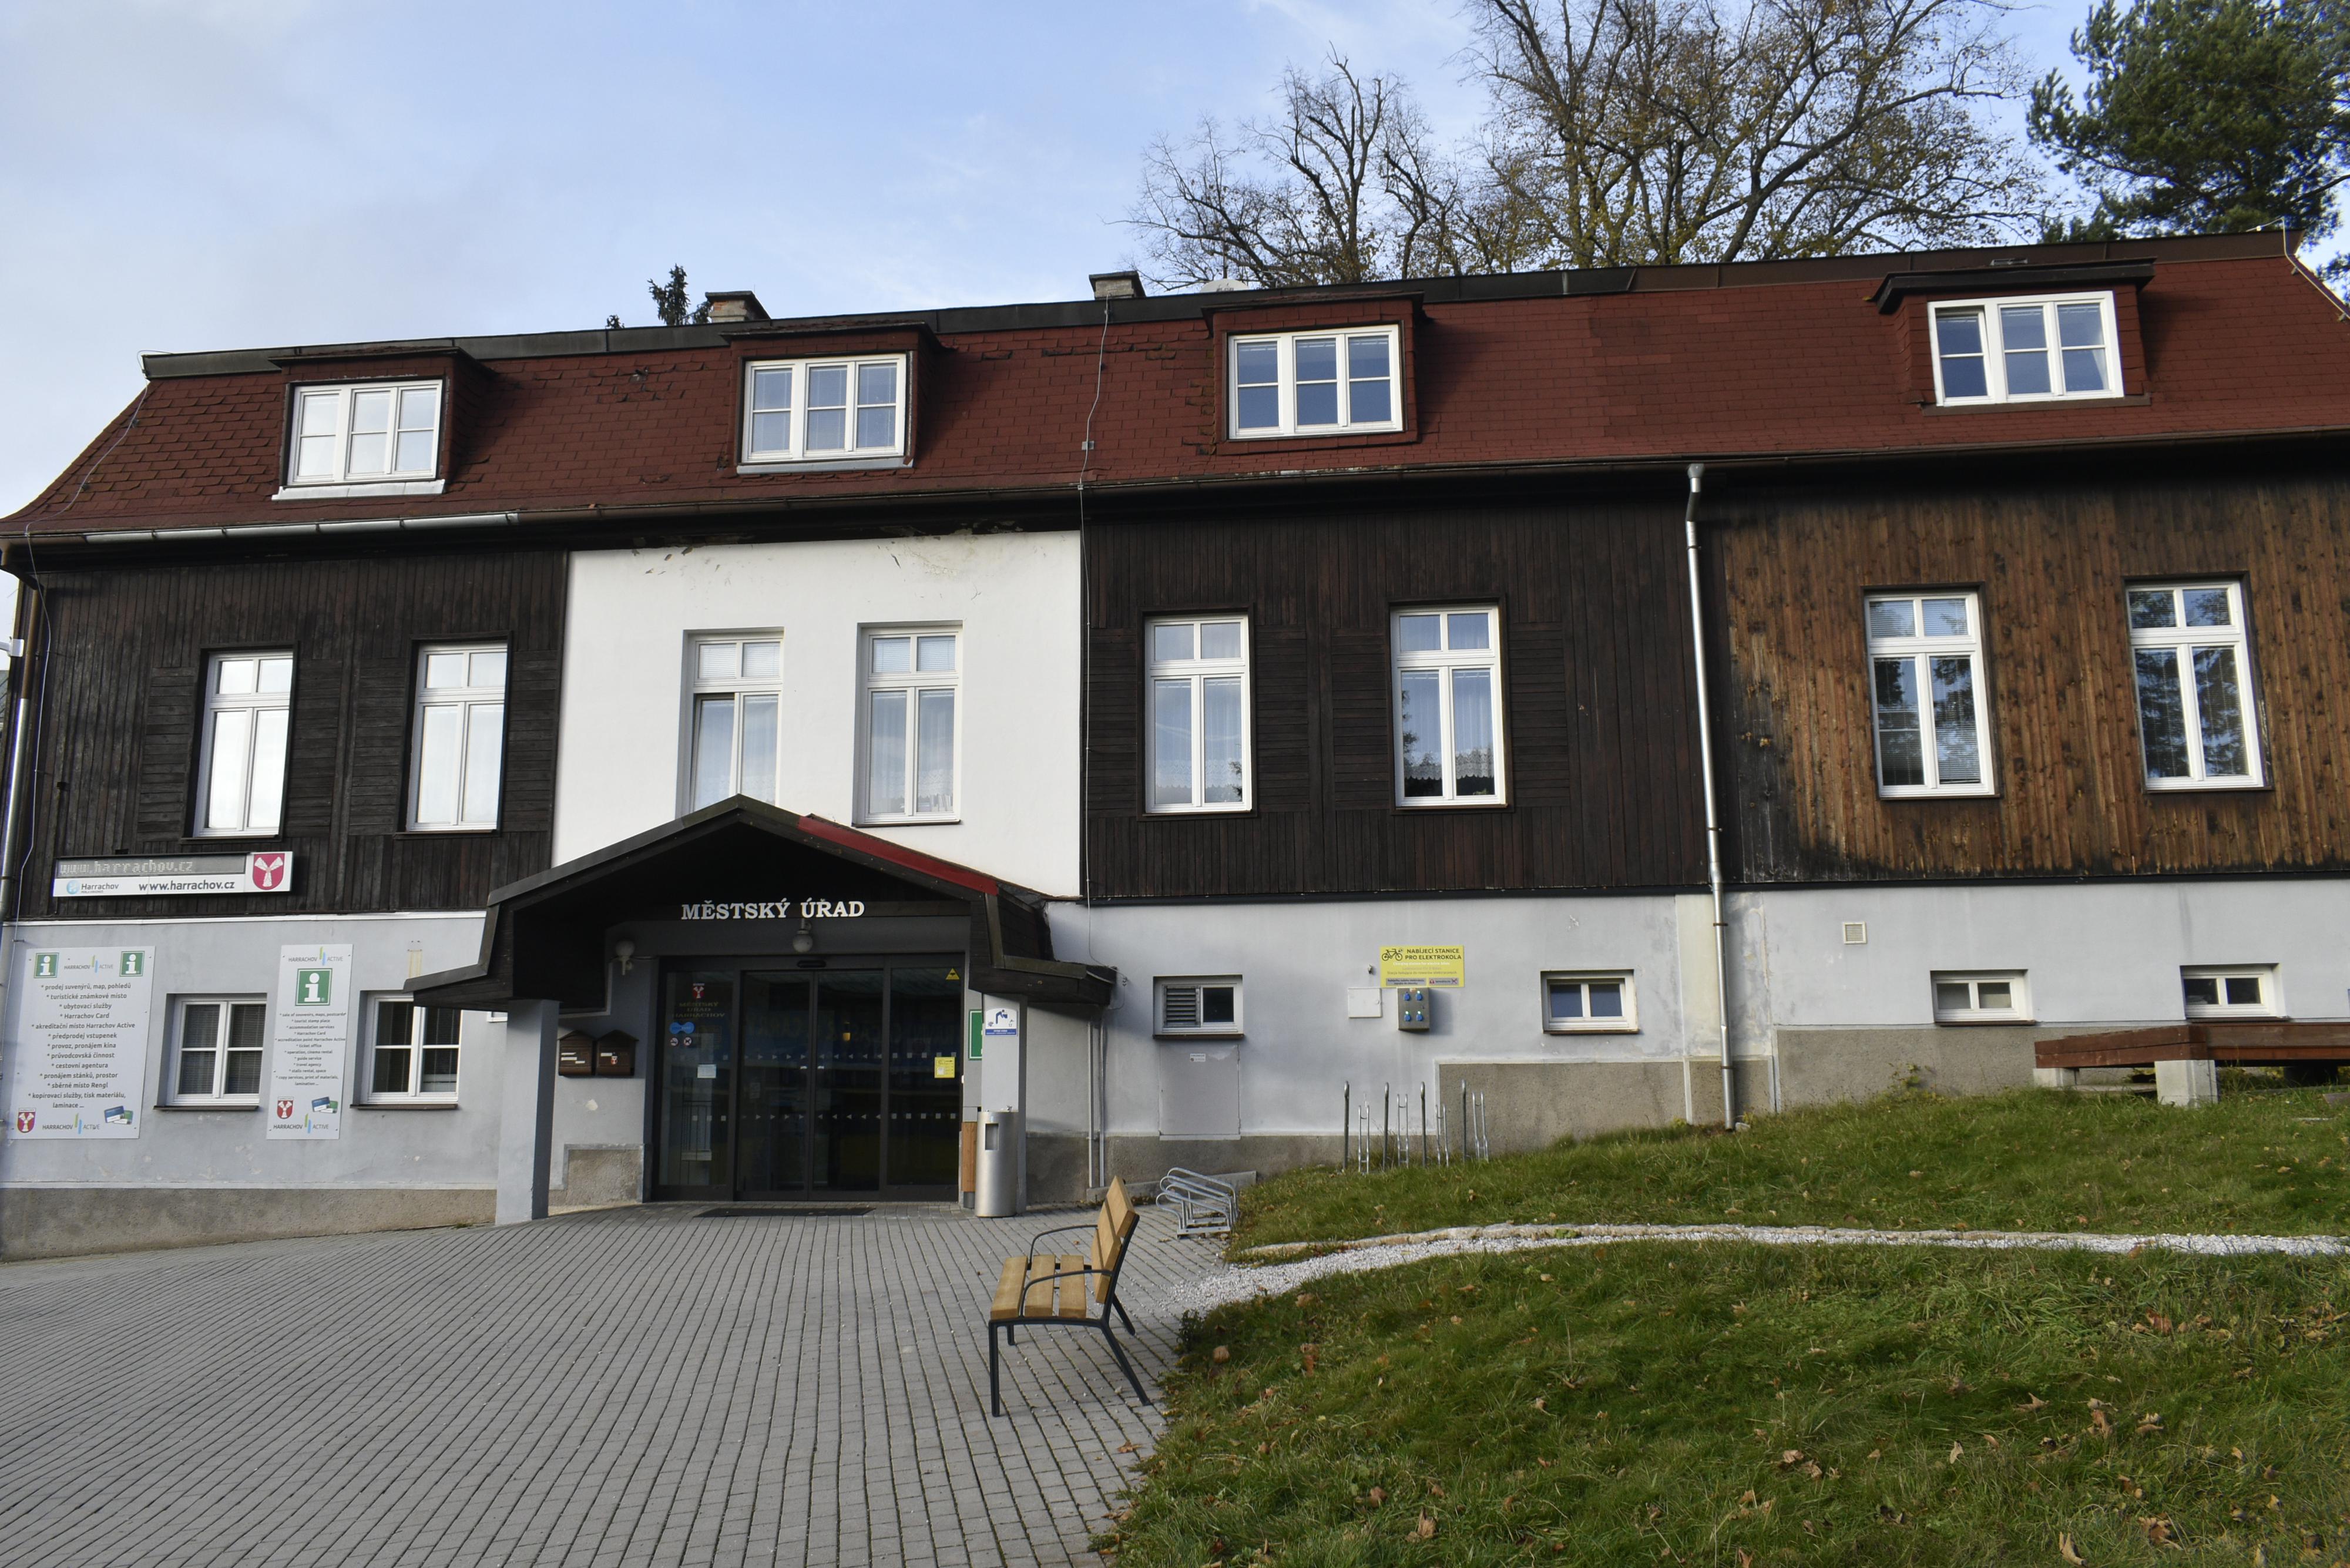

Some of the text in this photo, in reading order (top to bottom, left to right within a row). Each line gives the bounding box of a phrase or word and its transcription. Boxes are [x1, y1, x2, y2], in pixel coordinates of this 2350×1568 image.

[61, 860, 193, 874] www.harrachov.cz
[139, 879, 235, 891] www.harrachov.cz
[682, 898, 865, 919] MĚSTSKÝ ÚŘAD
